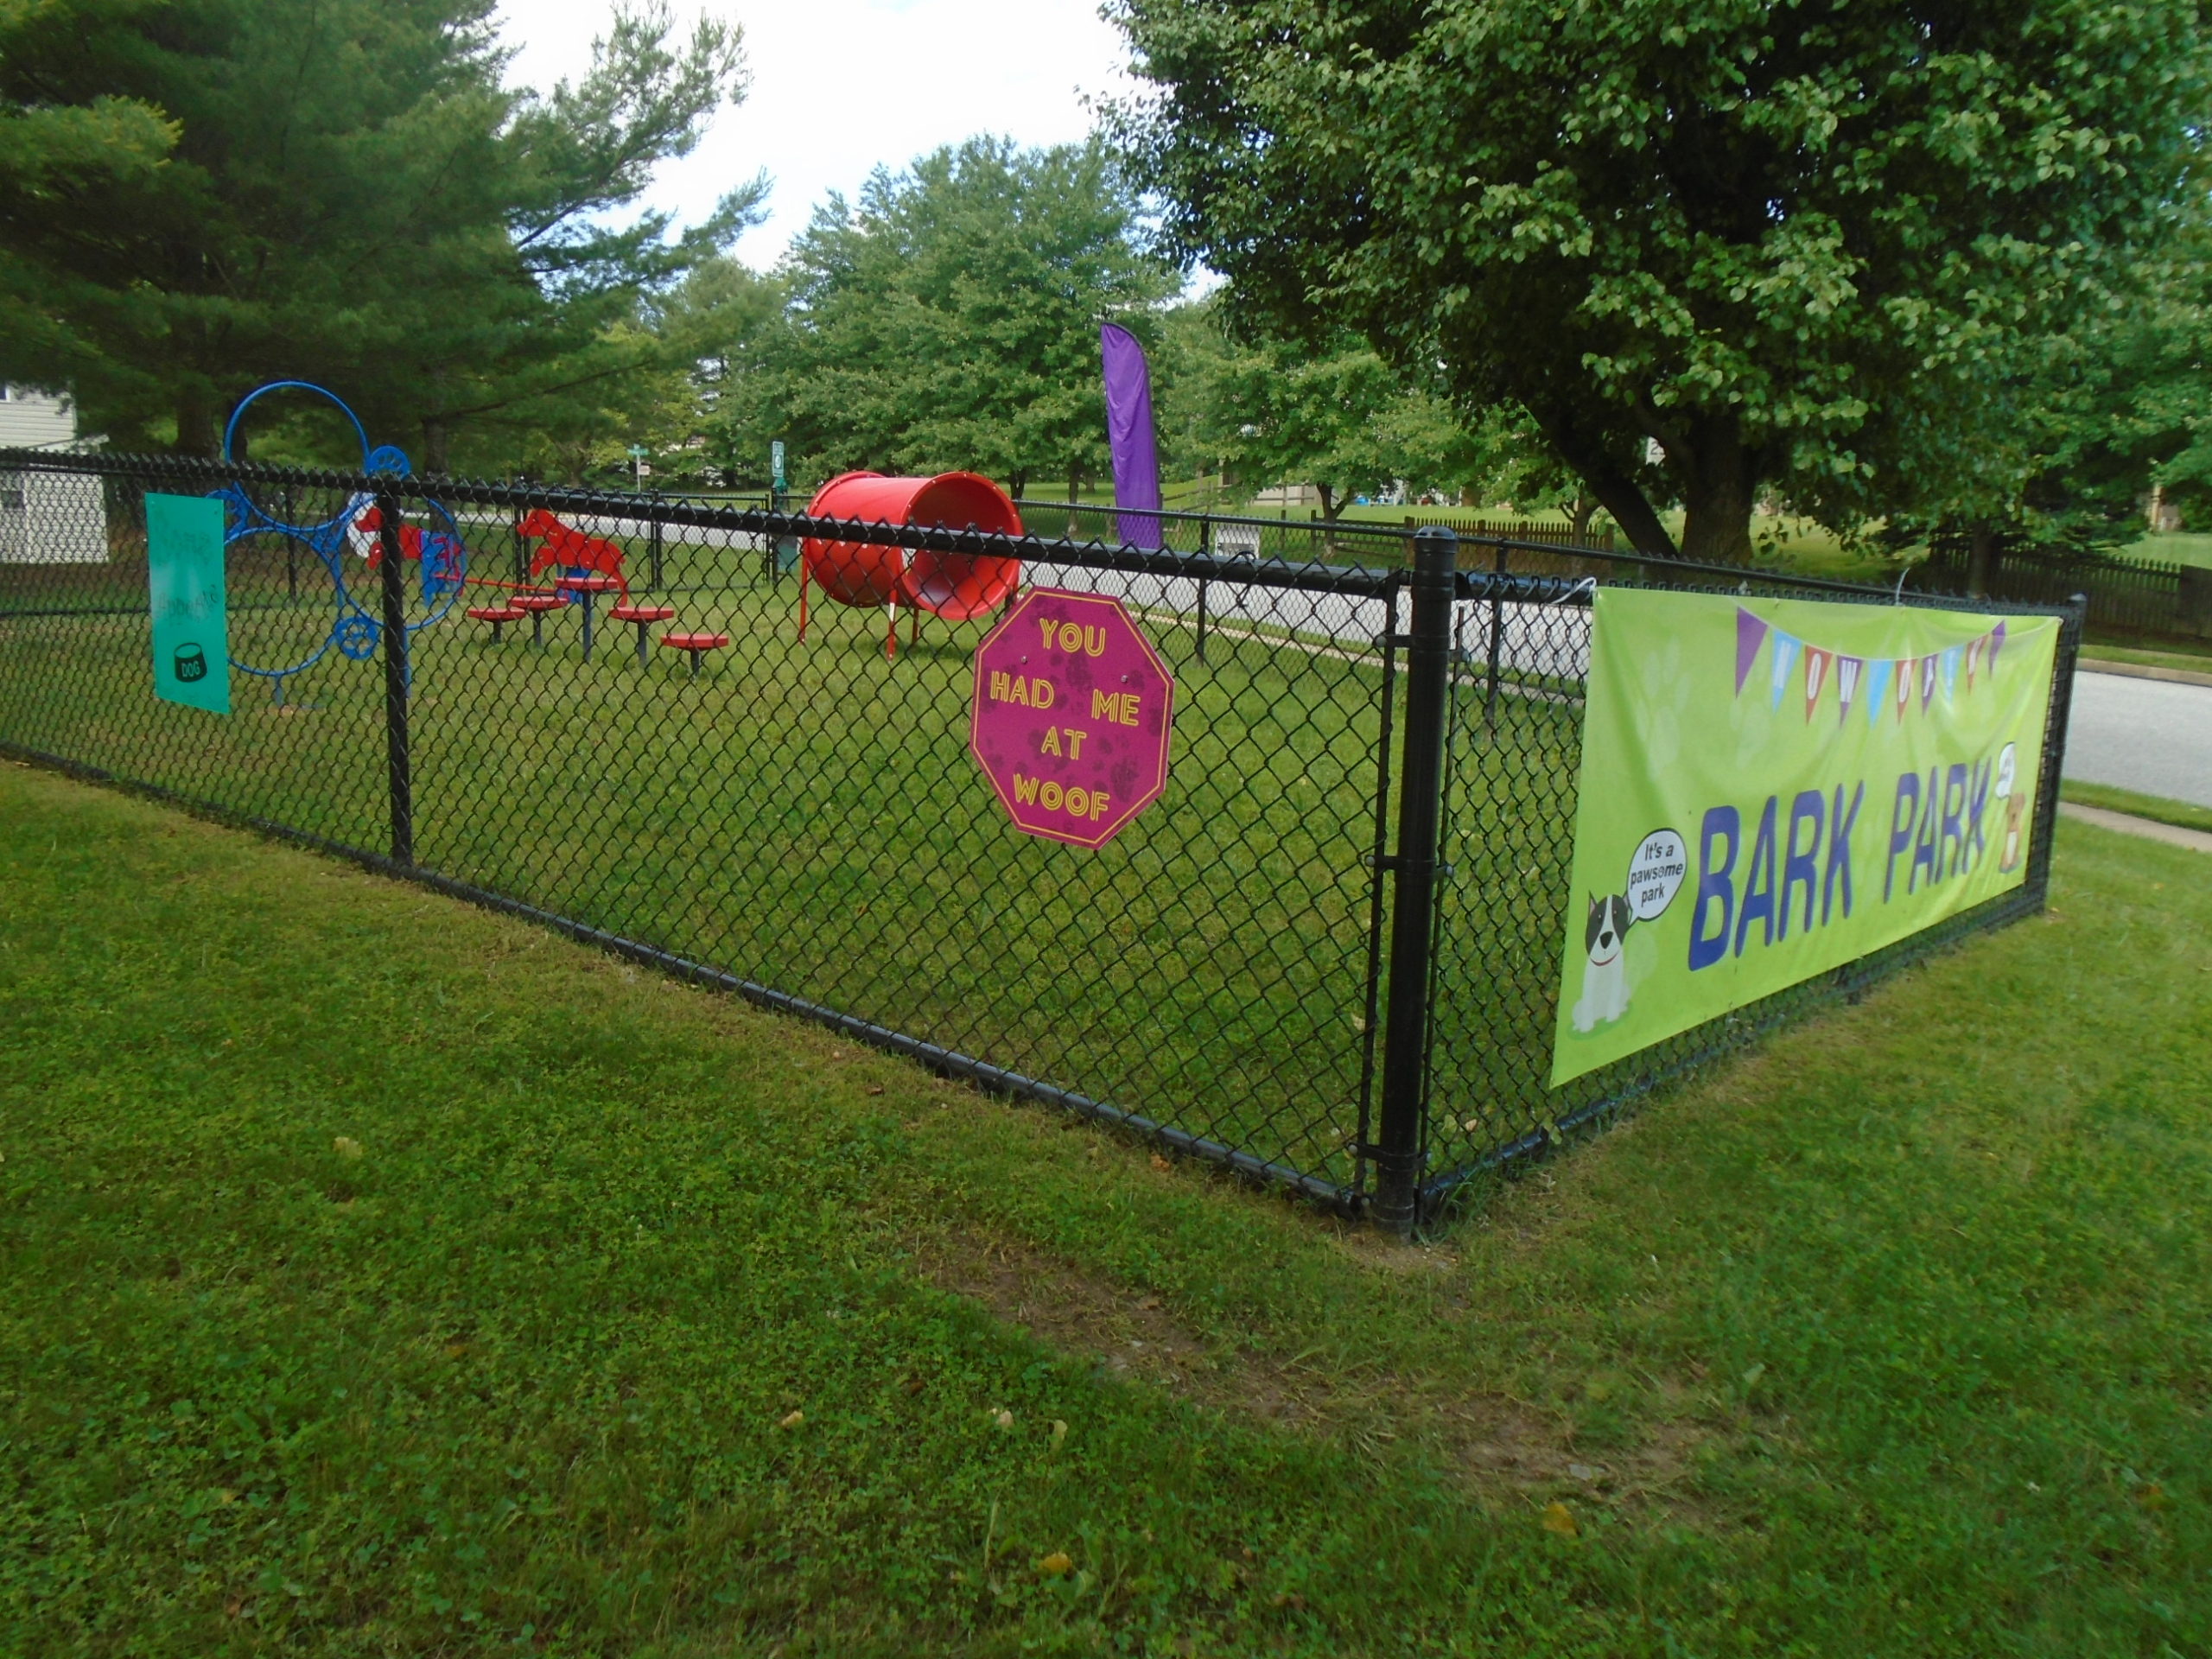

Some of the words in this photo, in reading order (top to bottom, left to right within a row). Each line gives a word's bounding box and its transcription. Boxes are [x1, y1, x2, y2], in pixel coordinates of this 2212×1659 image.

[1039, 618, 1106, 657] YOU
[181, 660, 200, 677] DOG
[1773, 639, 1858, 703] NOW
[990, 671, 1054, 709] HAD
[1091, 689, 1141, 726] ME
[1041, 726, 1087, 760] AT
[1014, 773, 1109, 821] WOOF
[1645, 843, 1662, 860] It's
[1666, 845, 1674, 856] a
[1688, 779, 1865, 972] BARK
[1884, 756, 1992, 904] PARK
[1631, 864, 1683, 888] pawsome
[1642, 883, 1665, 906] park
